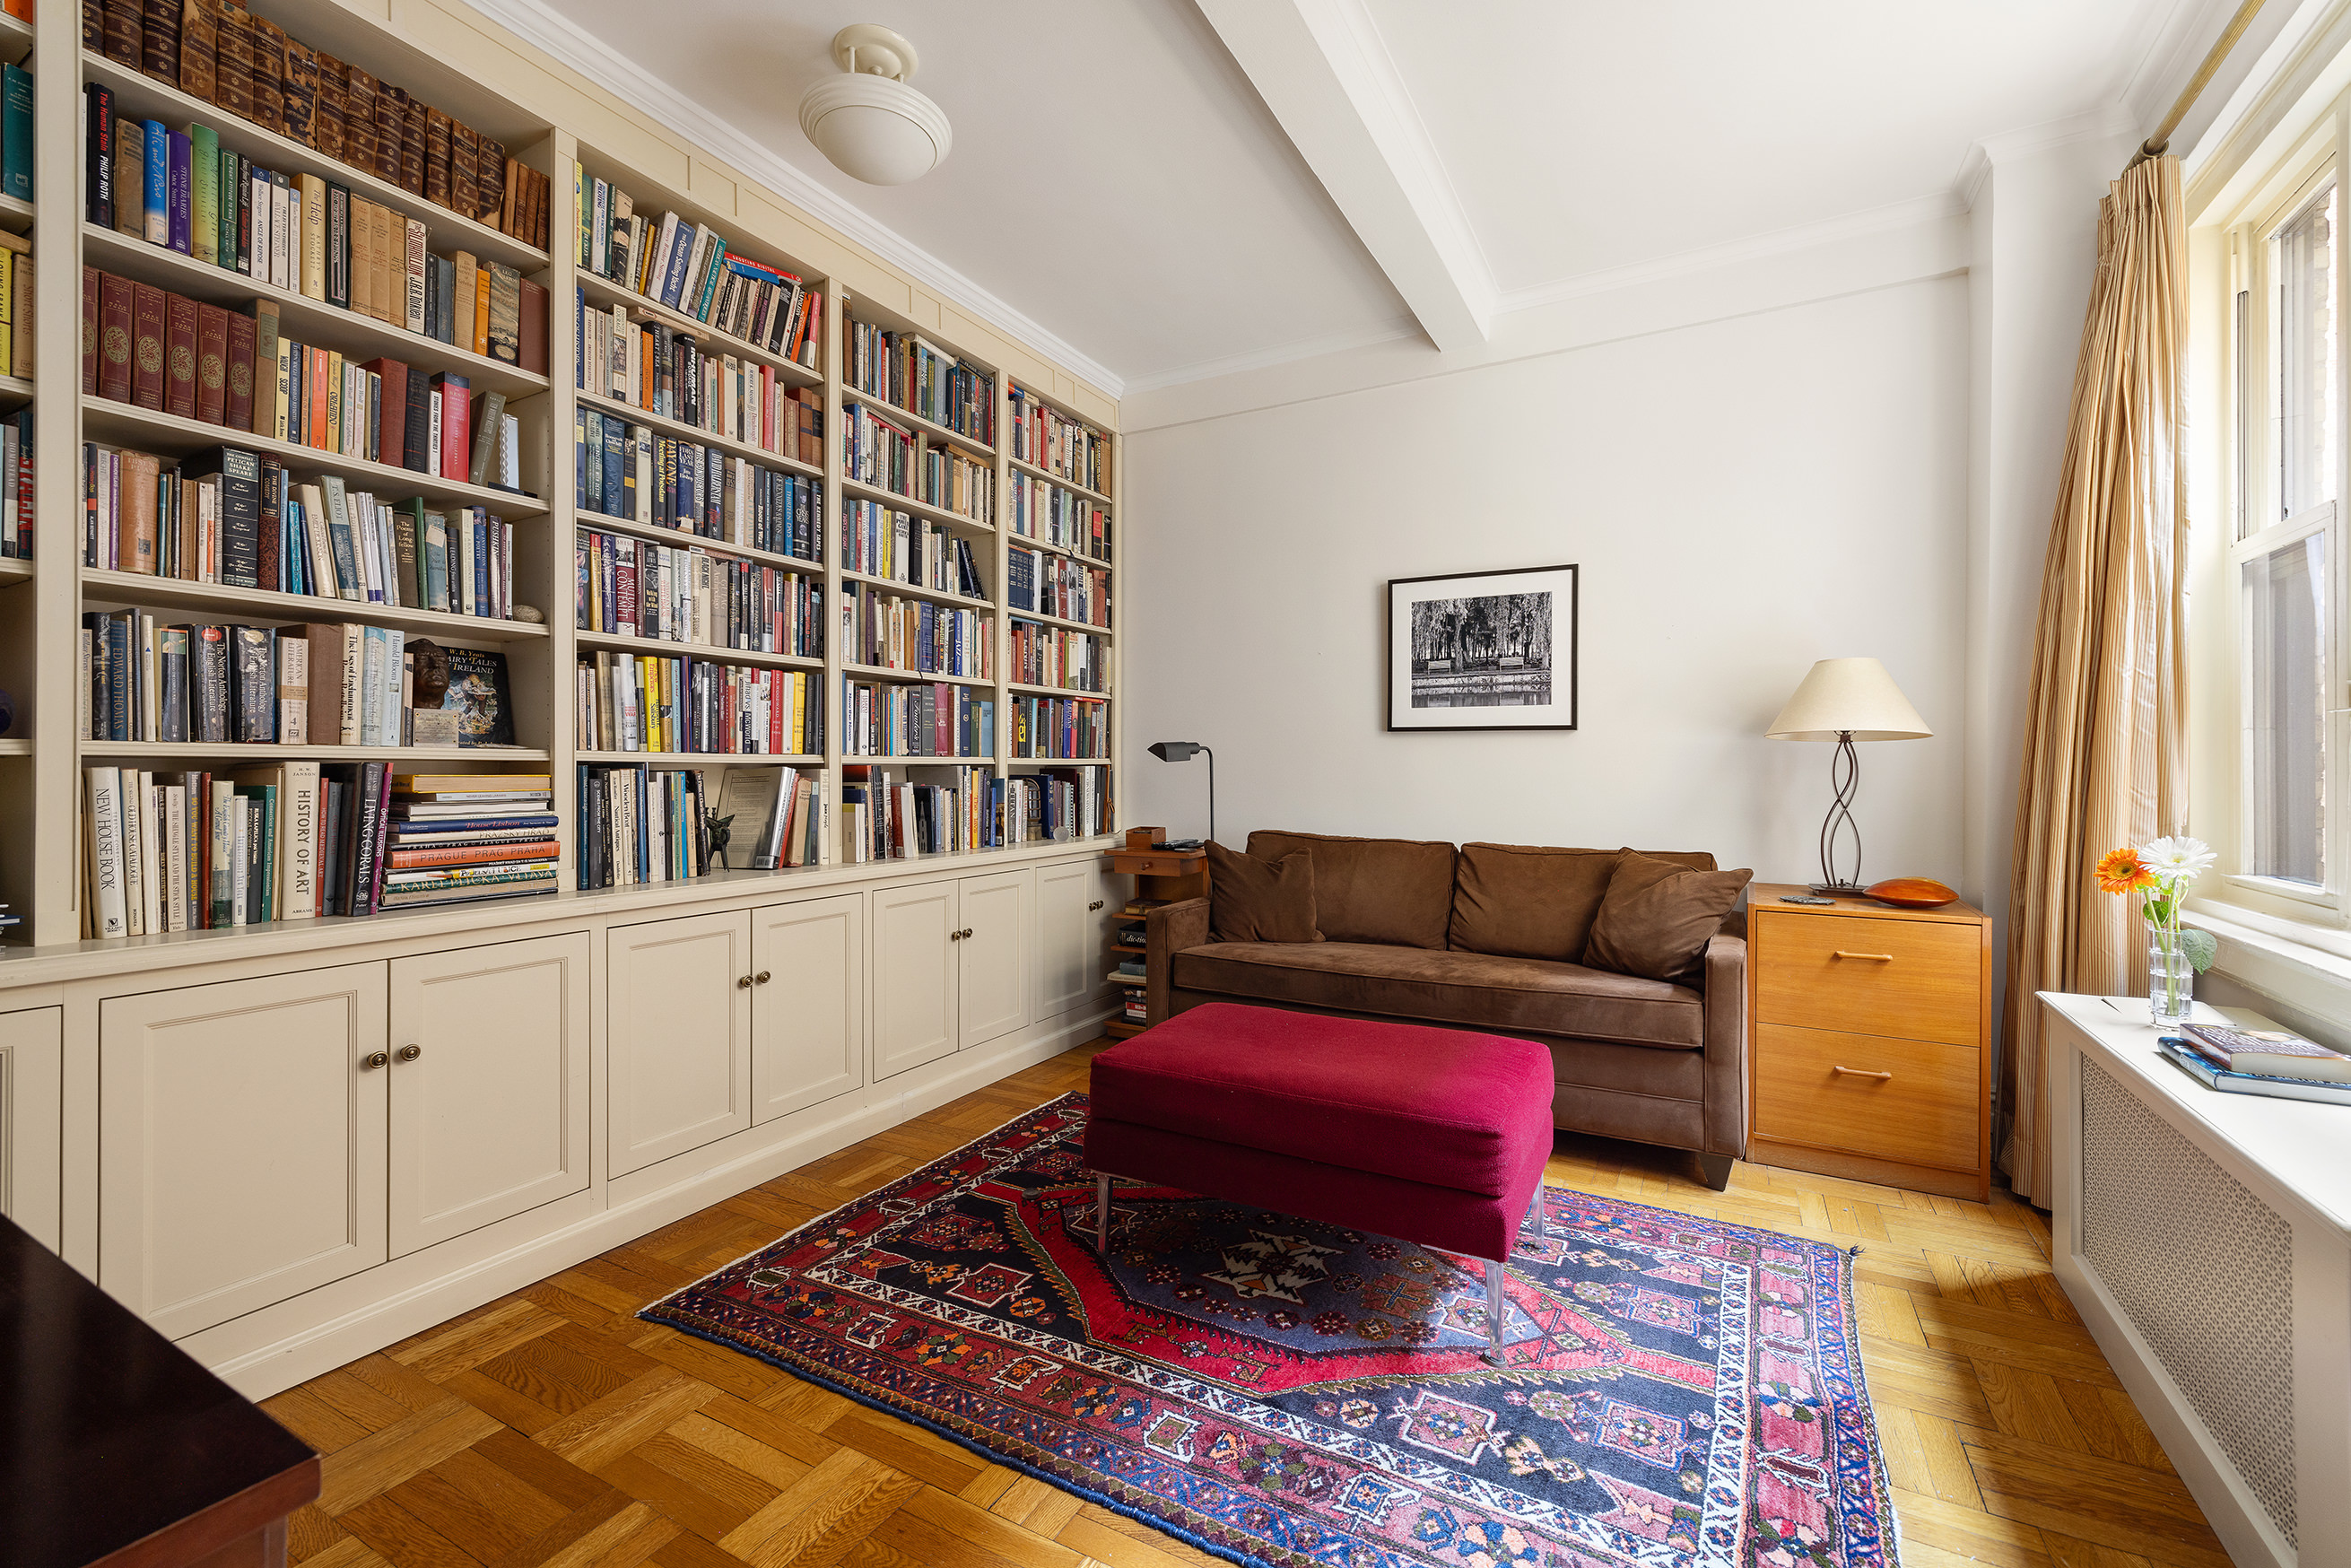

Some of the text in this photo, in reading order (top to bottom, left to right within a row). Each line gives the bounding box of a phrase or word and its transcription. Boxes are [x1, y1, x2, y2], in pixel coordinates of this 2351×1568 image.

[100, 92, 108, 151] The Human Stain
[100, 155, 108, 200] PHILIP ROTH
[308, 201, 322, 225] Help
[661, 242, 669, 262] Weather
[677, 240, 686, 256] Ocean
[671, 257, 682, 275] Sailing
[669, 276, 677, 292] Yacht
[280, 355, 288, 395] WAUGH SCOOP
[227, 457, 255, 466] PELICAN
[229, 468, 252, 476] SPEARE
[230, 463, 253, 471] SHAKE-
[666, 440, 676, 486] DAY ONE
[335, 497, 343, 520] ELIOT
[314, 531, 323, 561] DICKINSON
[617, 571, 628, 619] CONTEMPT
[205, 653, 214, 677] English
[391, 635, 400, 680] Harold Bloom
[454, 664, 494, 674] IRELAND
[113, 648, 124, 729] EDWARD THOMAS
[217, 643, 226, 711] The Norton Anthology
[648, 664, 656, 693] Emperors
[208, 680, 216, 711] Literature
[96, 788, 115, 890] NEW HOUSE BOOK
[128, 821, 136, 843] HOUSE
[296, 790, 310, 894] HISTORY OF ART
[358, 798, 376, 884] LIVING CORALS
[376, 830, 385, 858] ILLUSIONS
[191, 843, 198, 851] TO
[421, 846, 545, 861] PRAGUE PRAG PRAHA
[129, 844, 137, 885] CATALOGUE
[400, 872, 553, 891] KAREL PLICKA VLTAVA
